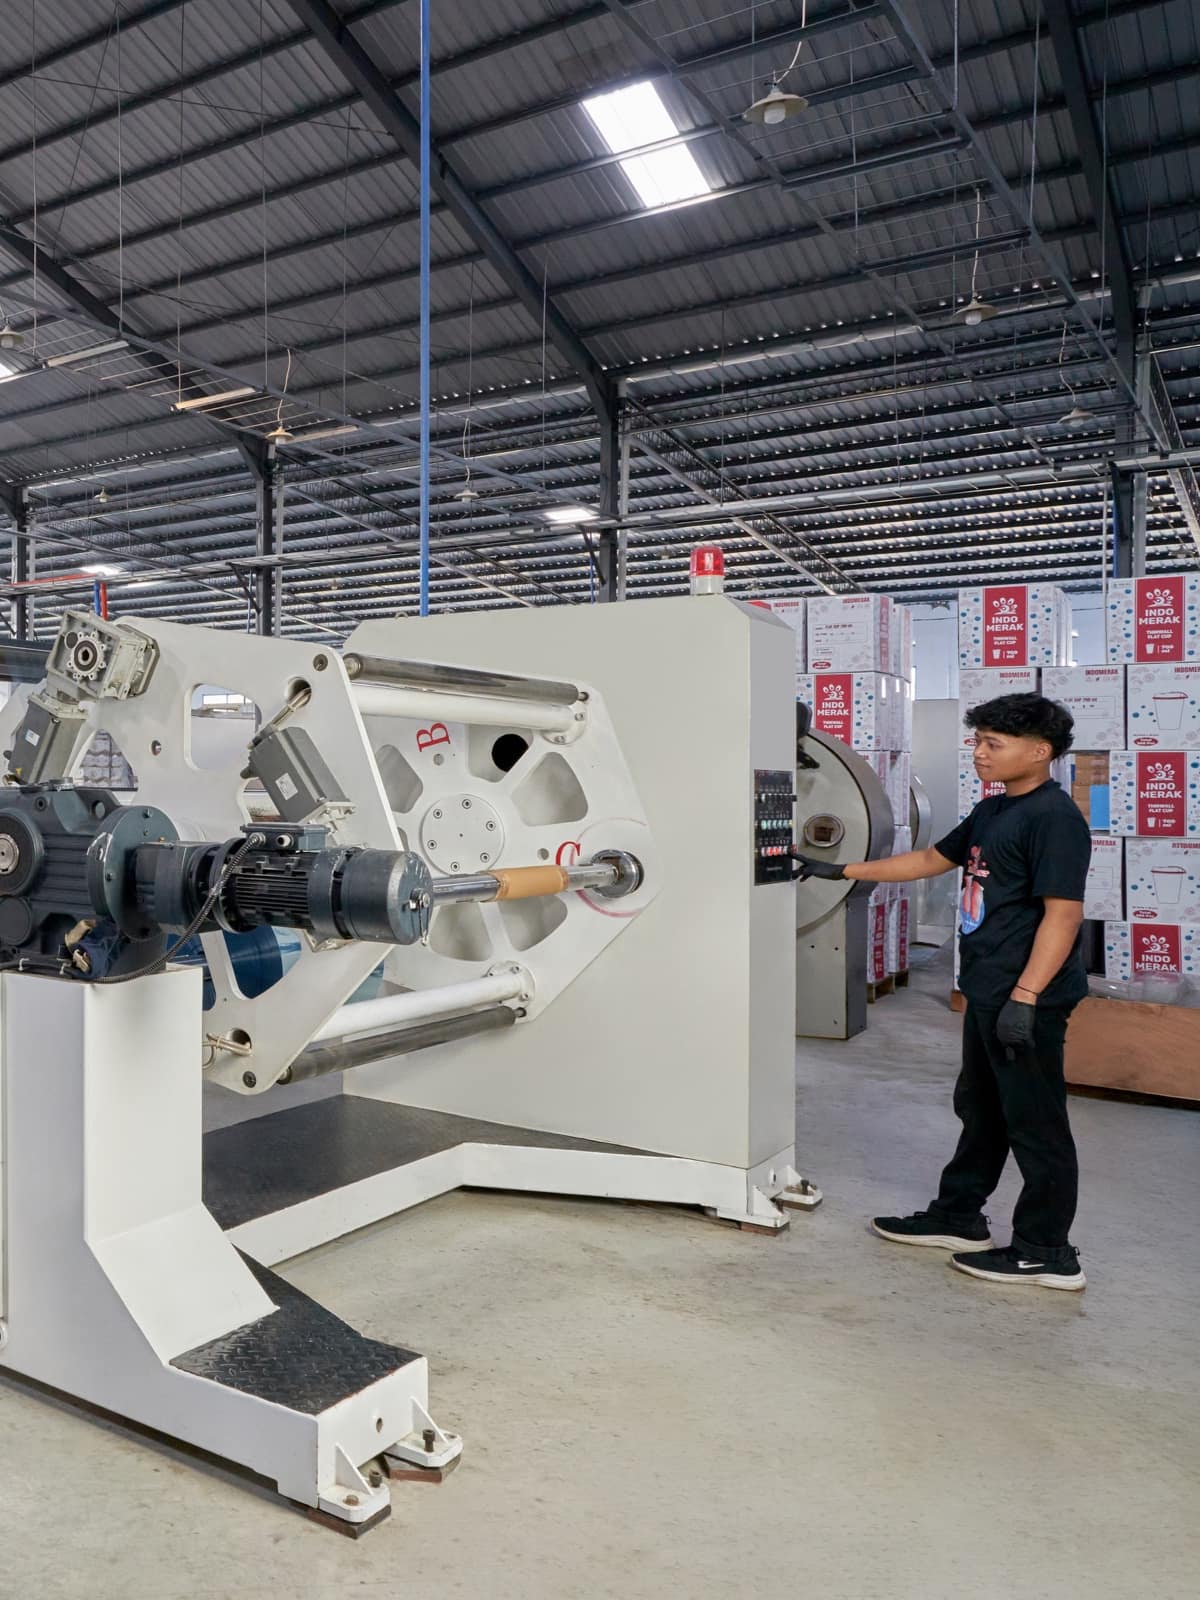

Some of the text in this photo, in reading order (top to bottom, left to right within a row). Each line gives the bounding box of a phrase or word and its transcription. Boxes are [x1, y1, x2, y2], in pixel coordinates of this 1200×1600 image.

[1145, 608, 1174, 617] INDO
[991, 616, 1018, 624] INDO
[1138, 616, 1181, 625] MERAK
[986, 624, 1023, 632] MERAK
[822, 701, 845, 709] INDO
[416, 722, 451, 752] B
[1146, 782, 1176, 790] INDO
[985, 788, 1006, 796] MER
[1140, 790, 1182, 799] MERAK
[1141, 954, 1171, 963] INDO
[1135, 962, 1177, 972] MERAK
